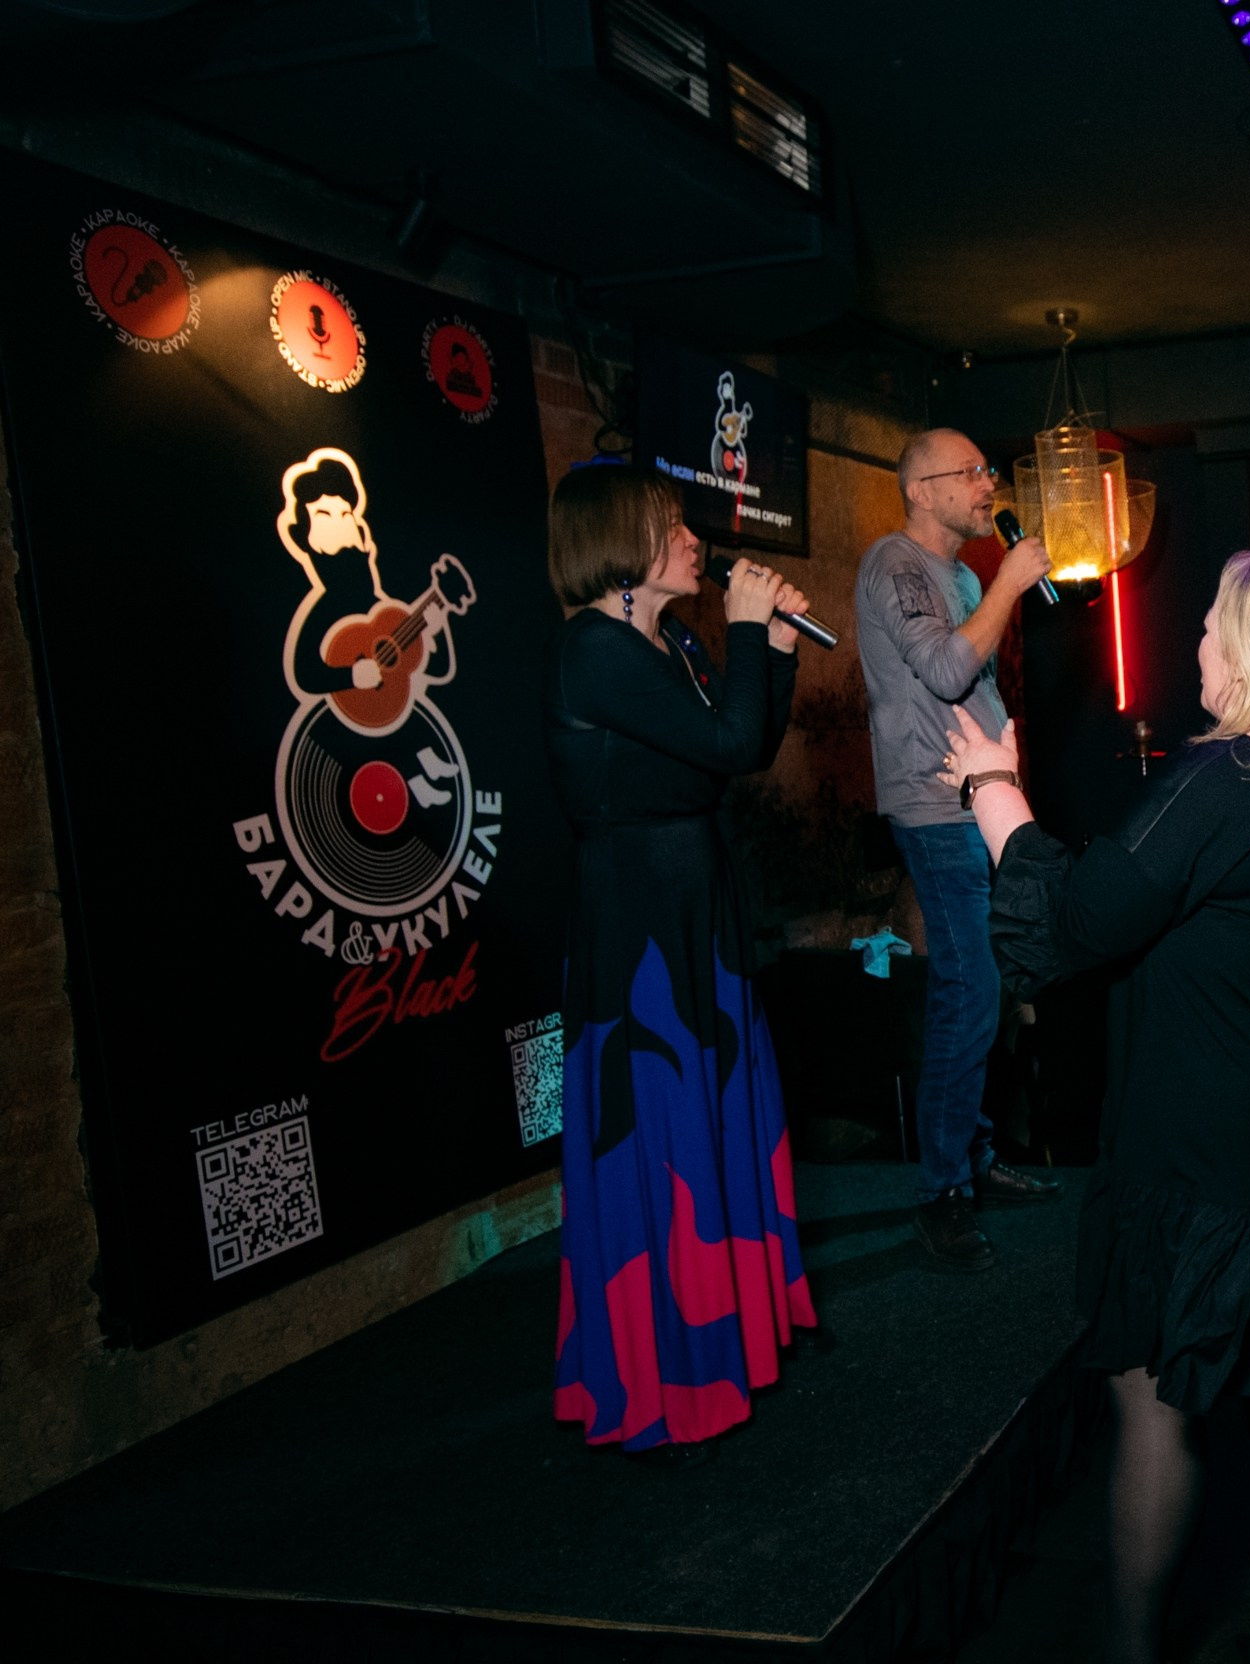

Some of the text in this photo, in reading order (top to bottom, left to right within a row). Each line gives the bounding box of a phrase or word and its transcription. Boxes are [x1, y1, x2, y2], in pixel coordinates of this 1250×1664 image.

[270, 271, 296, 307] OPEN
[322, 276, 367, 346] STAND UP
[269, 315, 318, 388] STAND UP
[695, 470, 717, 488] есть
[761, 509, 793, 528] сигарет
[319, 939, 480, 1063] Black
[504, 1011, 563, 1043] INSTAGR
[190, 1093, 309, 1146] TELEGRAM
